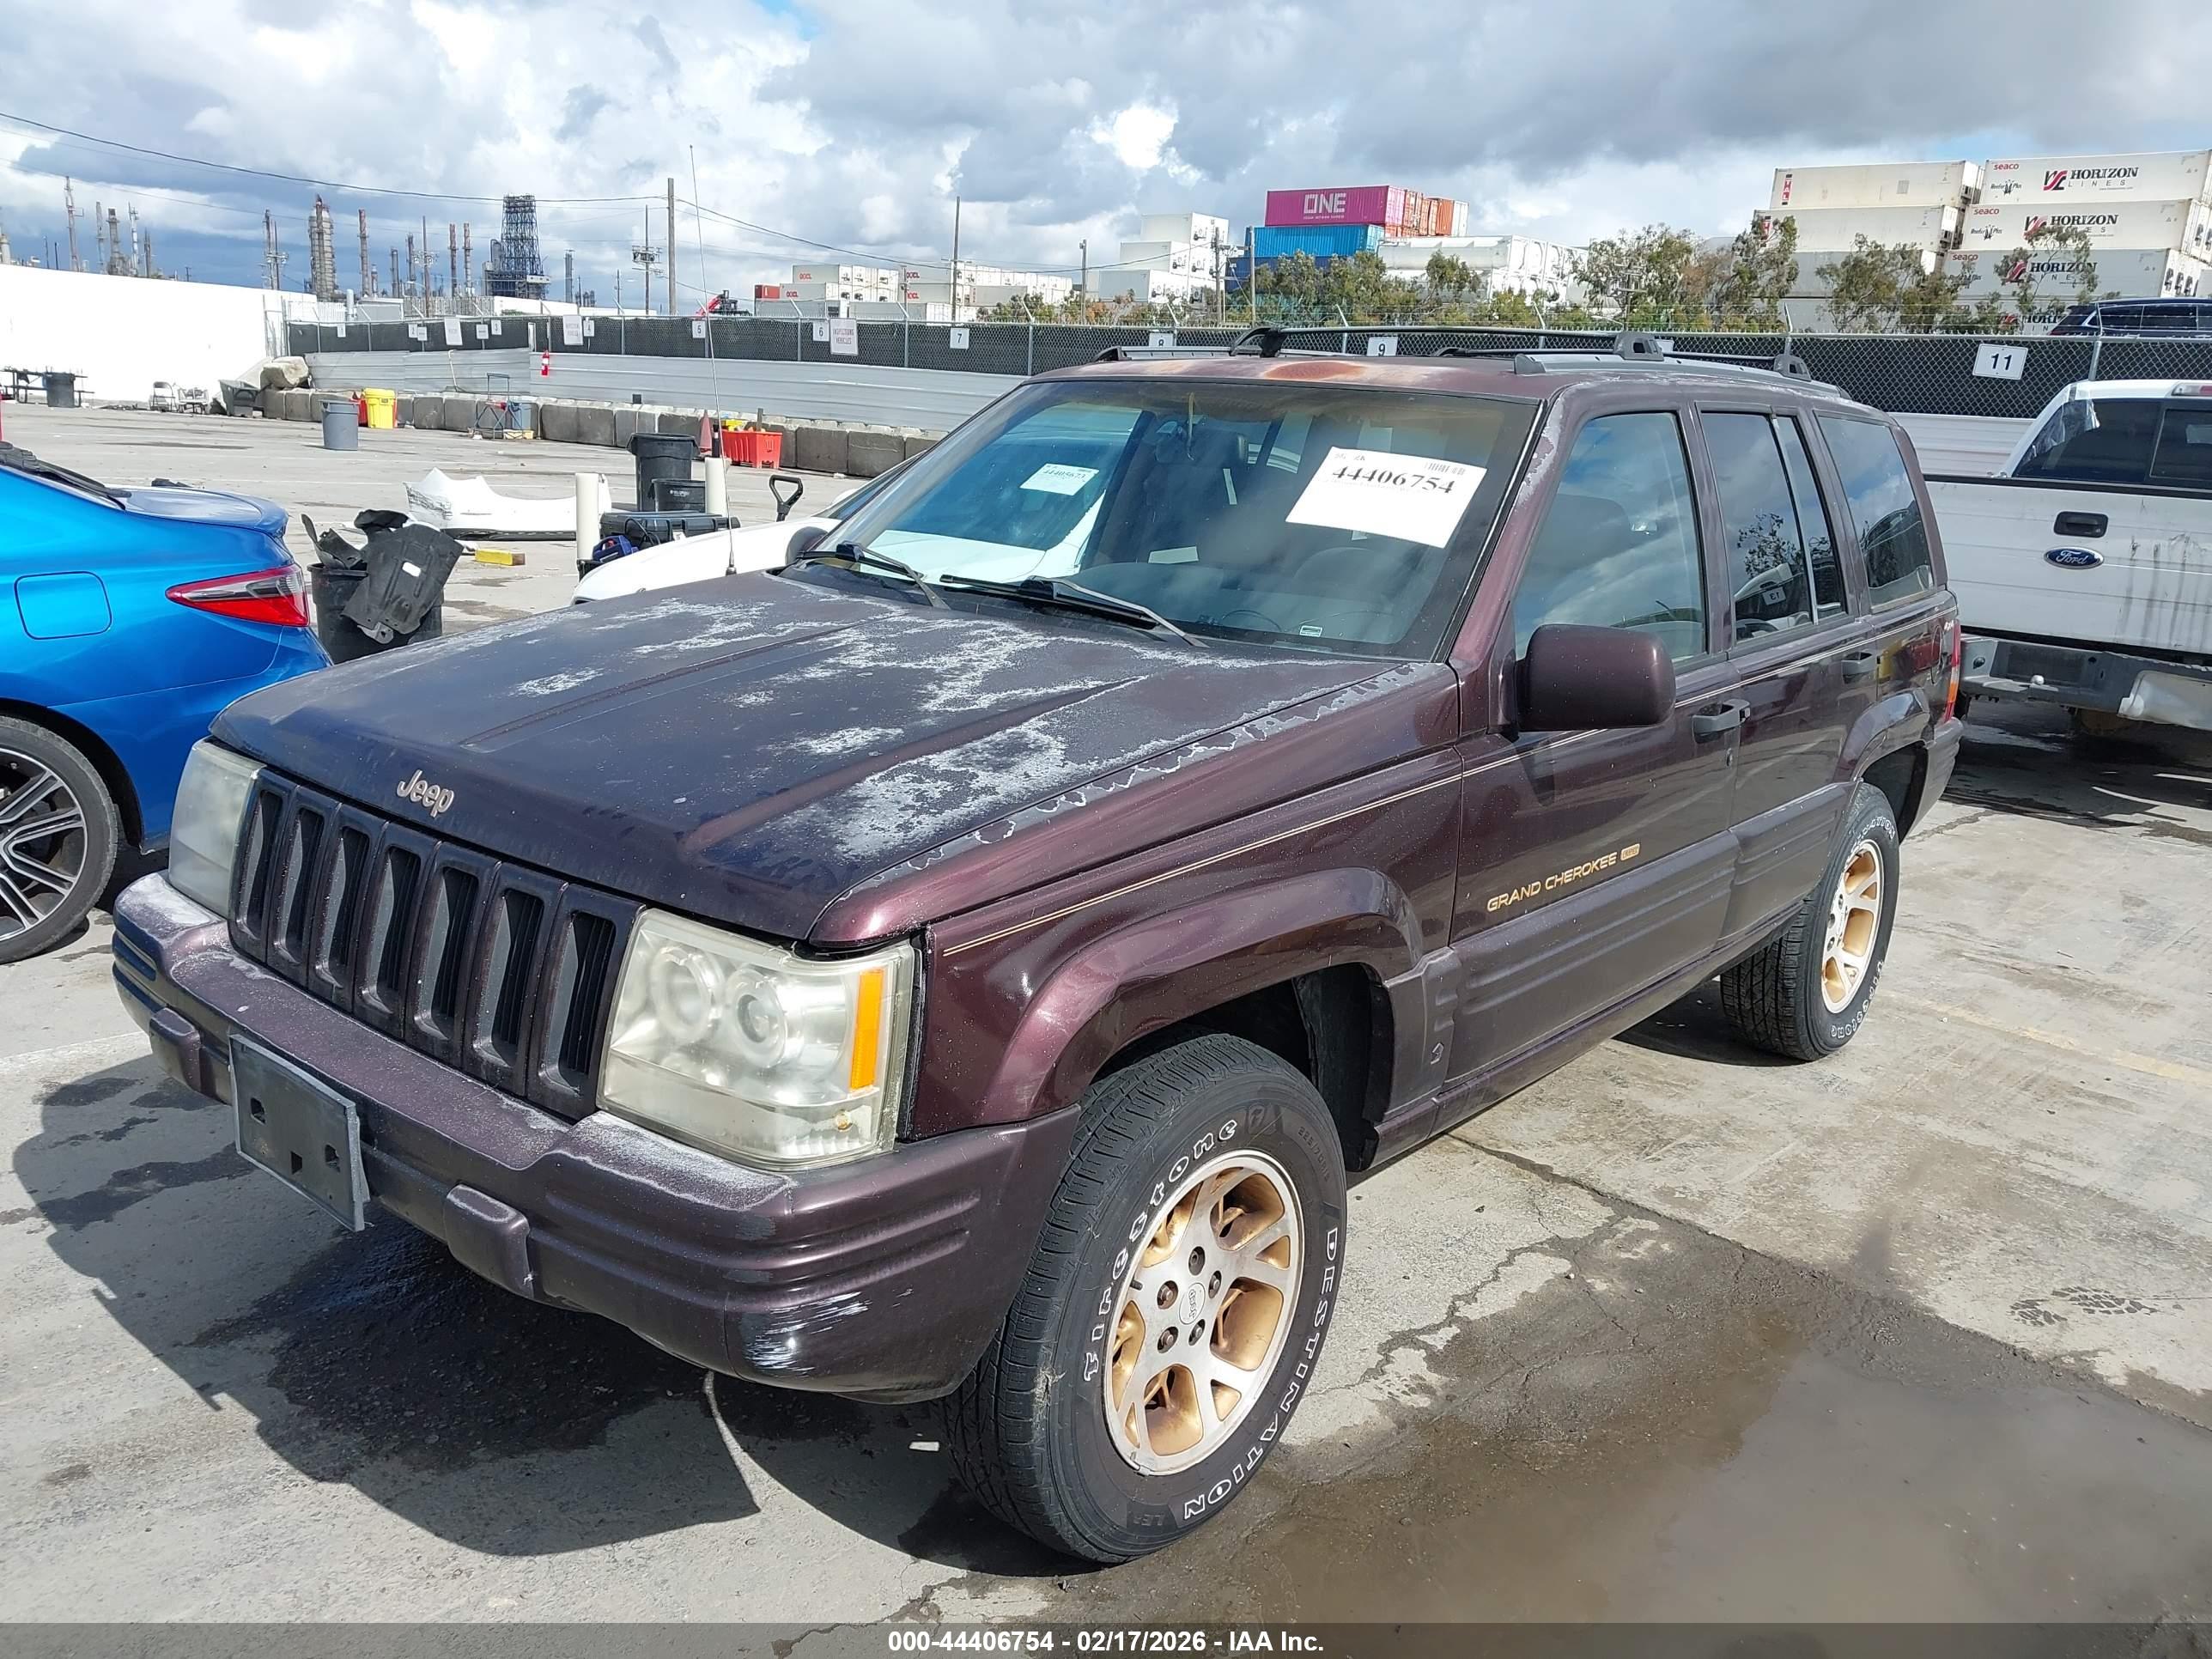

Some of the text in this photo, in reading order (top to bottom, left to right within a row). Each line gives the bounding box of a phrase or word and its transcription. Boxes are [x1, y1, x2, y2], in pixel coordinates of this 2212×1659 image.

[2070, 167, 2139, 179] HORIZON
[2069, 179, 2126, 188] LINES
[1304, 192, 1346, 214] ONE
[1974, 207, 2000, 216] seaco
[2051, 214, 2118, 226] HORIZON
[2030, 262, 2098, 273] HORIZON
[697, 325, 702, 334] 5
[818, 326, 824, 337] 6
[957, 333, 963, 344] 7
[1377, 343, 1385, 356] 9
[1991, 353, 2012, 371] 11
[1333, 466, 1455, 494] 44406754
[2055, 550, 2089, 564] Ford
[397, 769, 454, 817] Jeep
[1486, 852, 1618, 912] GRAND CHEROKEE
[1083, 1119, 1238, 1382] Firestone
[1183, 1226, 1340, 1520] DESTINATION
